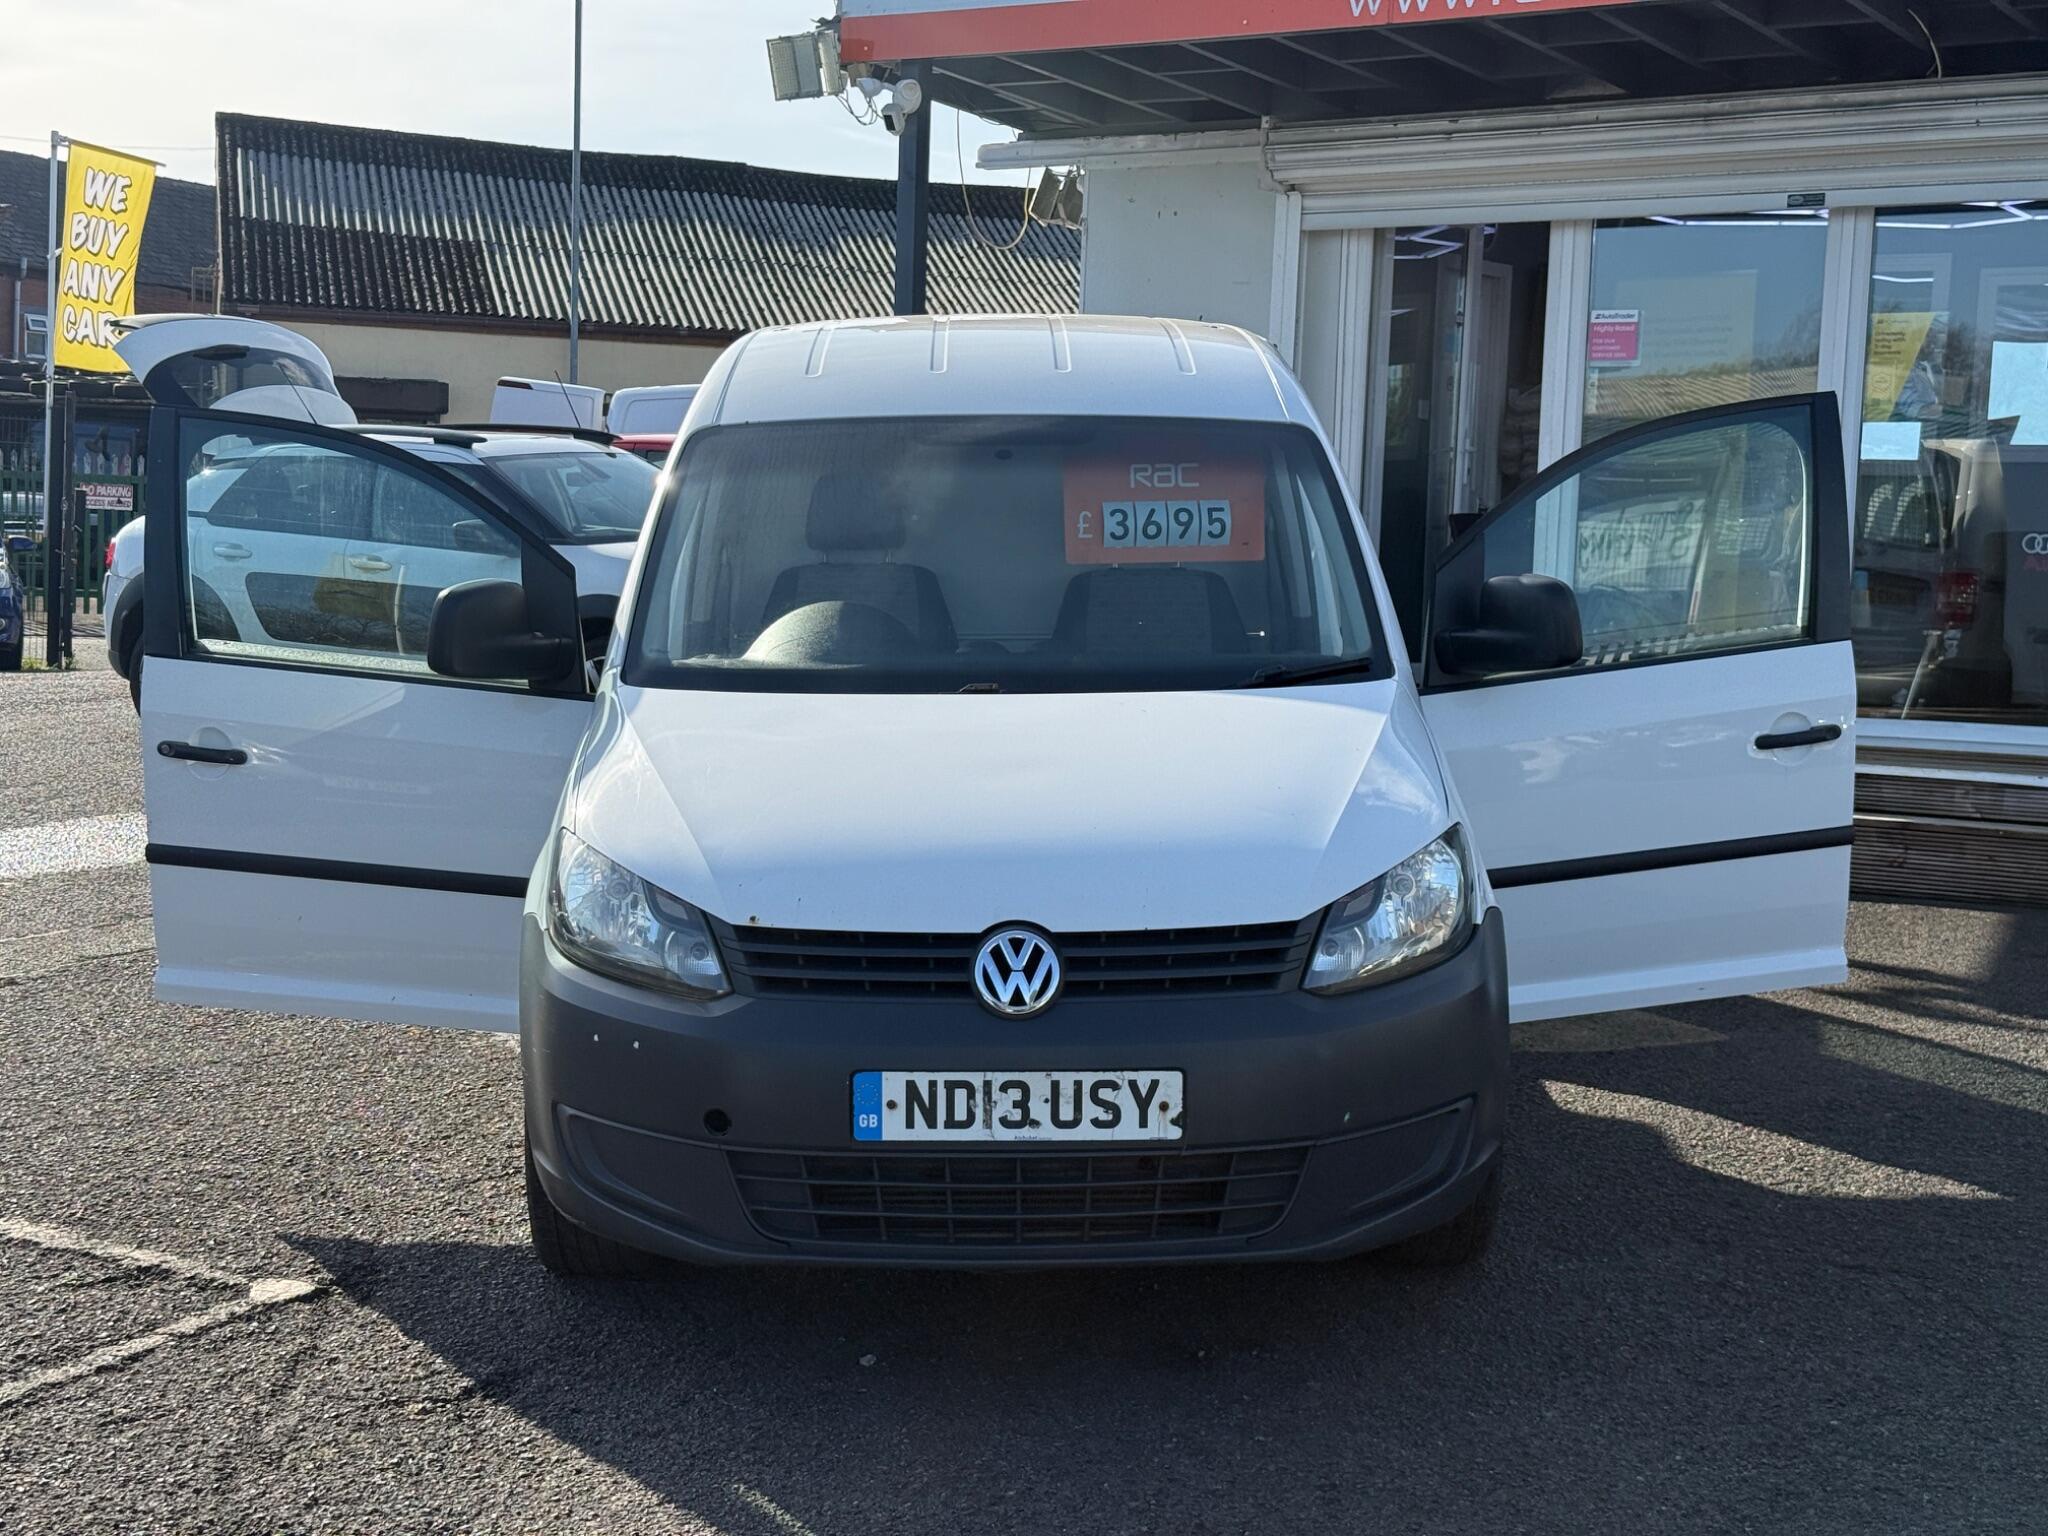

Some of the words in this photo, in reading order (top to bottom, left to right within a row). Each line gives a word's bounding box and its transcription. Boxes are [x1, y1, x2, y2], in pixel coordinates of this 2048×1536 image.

[83, 166, 132, 215] WE
[70, 211, 128, 260] BUY
[63, 257, 126, 305] ANY
[96, 485, 132, 497] PARKING
[1130, 463, 1200, 489] RAC
[858, 1113, 878, 1128] GB
[1050, 1079, 1160, 1129] USY
